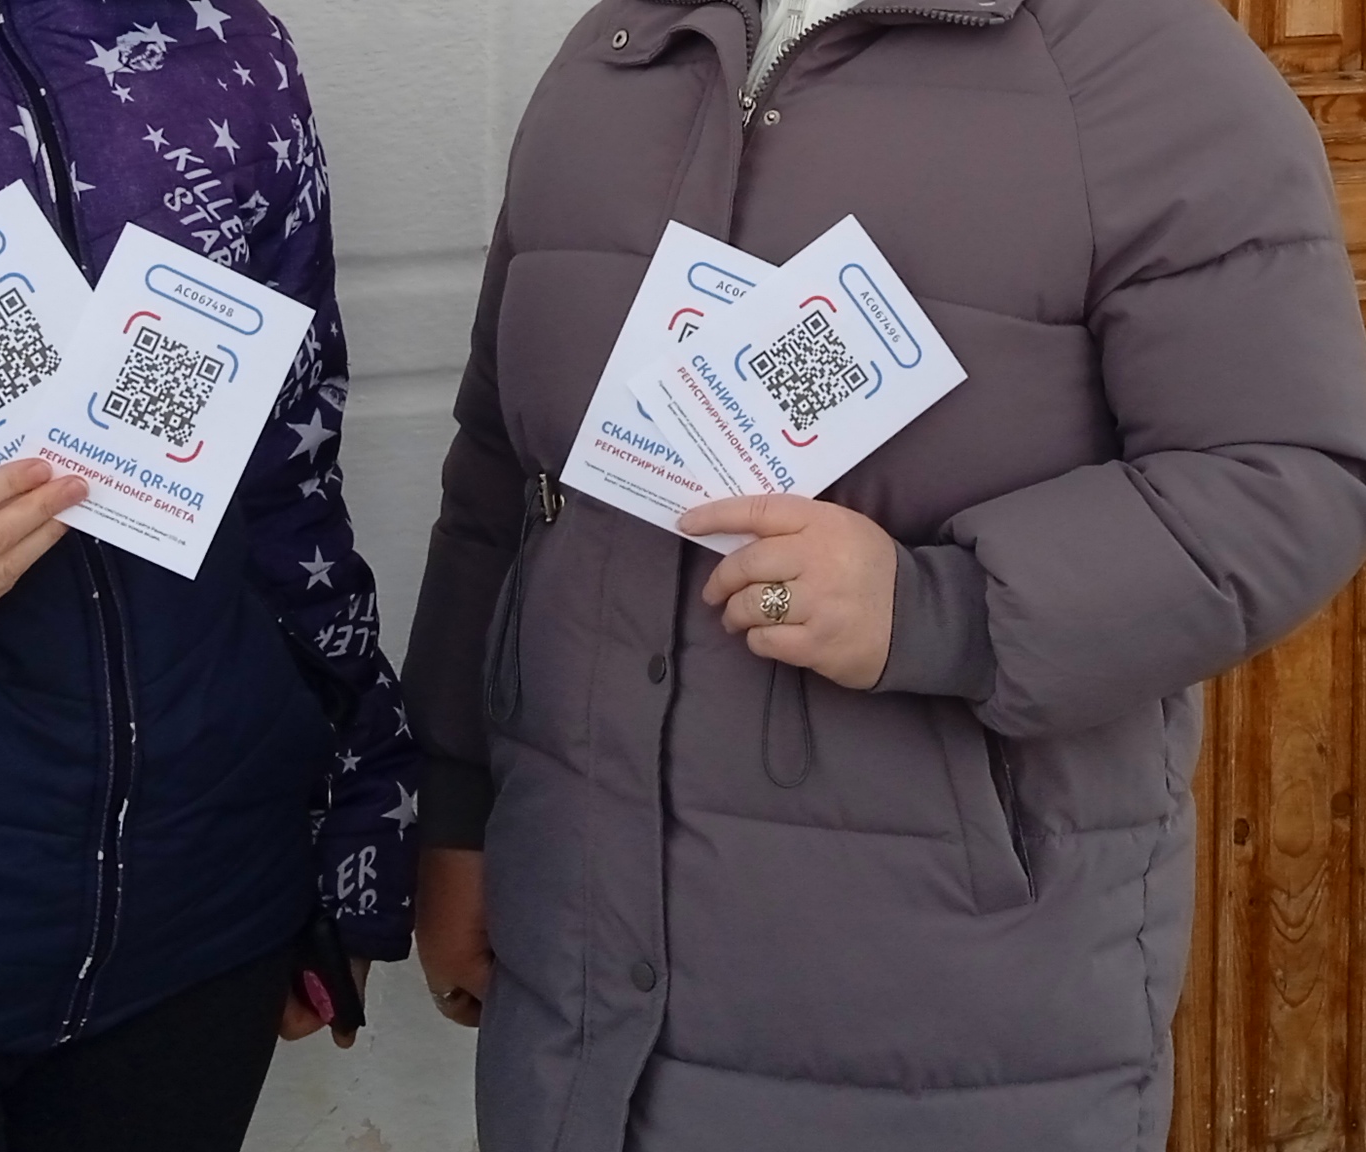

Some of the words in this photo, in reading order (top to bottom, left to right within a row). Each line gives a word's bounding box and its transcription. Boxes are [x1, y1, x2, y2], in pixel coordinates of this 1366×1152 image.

[163, 147, 250, 264] KILLER
[677, 367, 729, 431] РЕГИСТРИРУЙ
[724, 430, 753, 463] НОМЕР
[749, 463, 776, 495] БИЛЕТ
[691, 355, 756, 433] СКАНИРУЙ
[39, 447, 113, 487] РЕГИСТРИРУЙ
[114, 482, 153, 504] НОМЕР
[154, 499, 195, 524] БИЛЕТА
[48, 428, 137, 477] СКАНИРУЙ
[139, 469, 205, 511] QR-КОД
[595, 439, 666, 477] РЕГИСТРИРУЙ
[666, 471, 704, 492] НОМЕР
